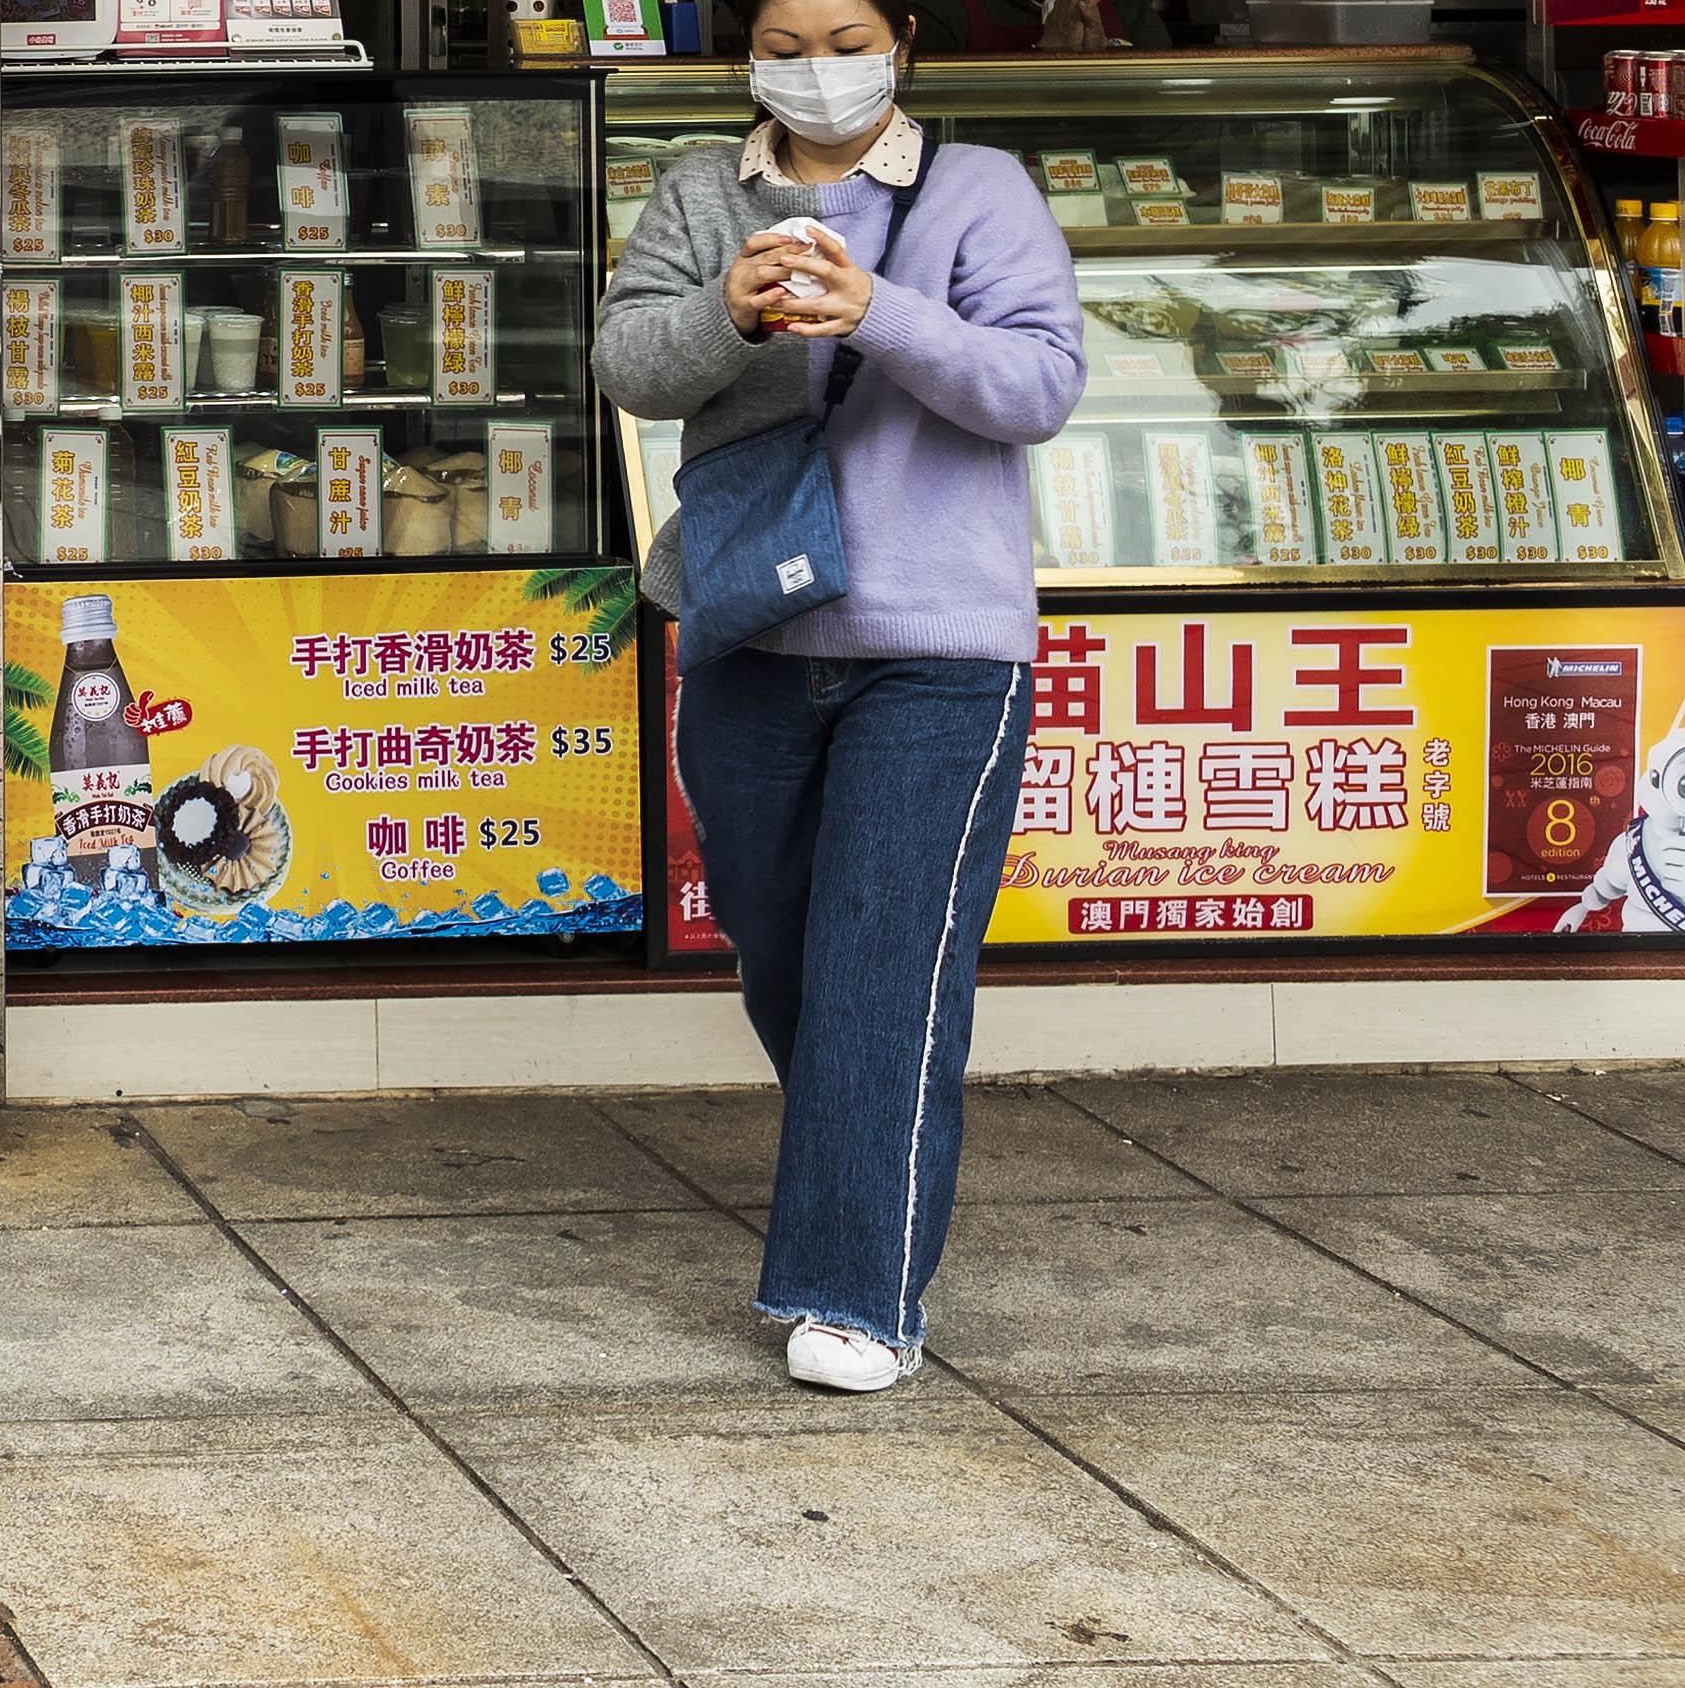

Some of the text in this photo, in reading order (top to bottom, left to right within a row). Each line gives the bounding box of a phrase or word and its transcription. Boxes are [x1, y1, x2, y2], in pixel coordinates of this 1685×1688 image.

[288, 141, 315, 208] 咖啡
[5, 288, 29, 389] 楊枝甘露
[131, 284, 155, 383] 椰汁西米露
[291, 280, 315, 378] 香滑手打奶茶
[52, 450, 76, 530] 菊花茶
[176, 440, 204, 539] 紅豆奶茶
[329, 446, 351, 534] 甘蔗汁
[1444, 443, 1480, 540] 紅豆奶茶
[290, 631, 613, 677] 手打香滑奶茶 $25
[1561, 664, 1619, 674] MICHELIN
[343, 676, 484, 700] Iced milk tea
[1504, 696, 1622, 710] Hong Kong Macau
[1525, 712, 1595, 730] 香港 澳門
[290, 724, 614, 770] 手打曲奇奶茶 $35
[1530, 752, 1593, 776] 2016
[325, 771, 410, 794] Cookies
[1422, 738, 1453, 833] 老字號
[1530, 777, 1593, 790] 米芝蓮指南
[366, 814, 541, 856] 咖啡 $25
[1544, 799, 1577, 847] 8
[379, 857, 456, 882] Coffee
[999, 847, 1161, 891] Durian
[1102, 837, 1282, 864] Musang king
[1080, 896, 1305, 930] 澳門獨家始創
